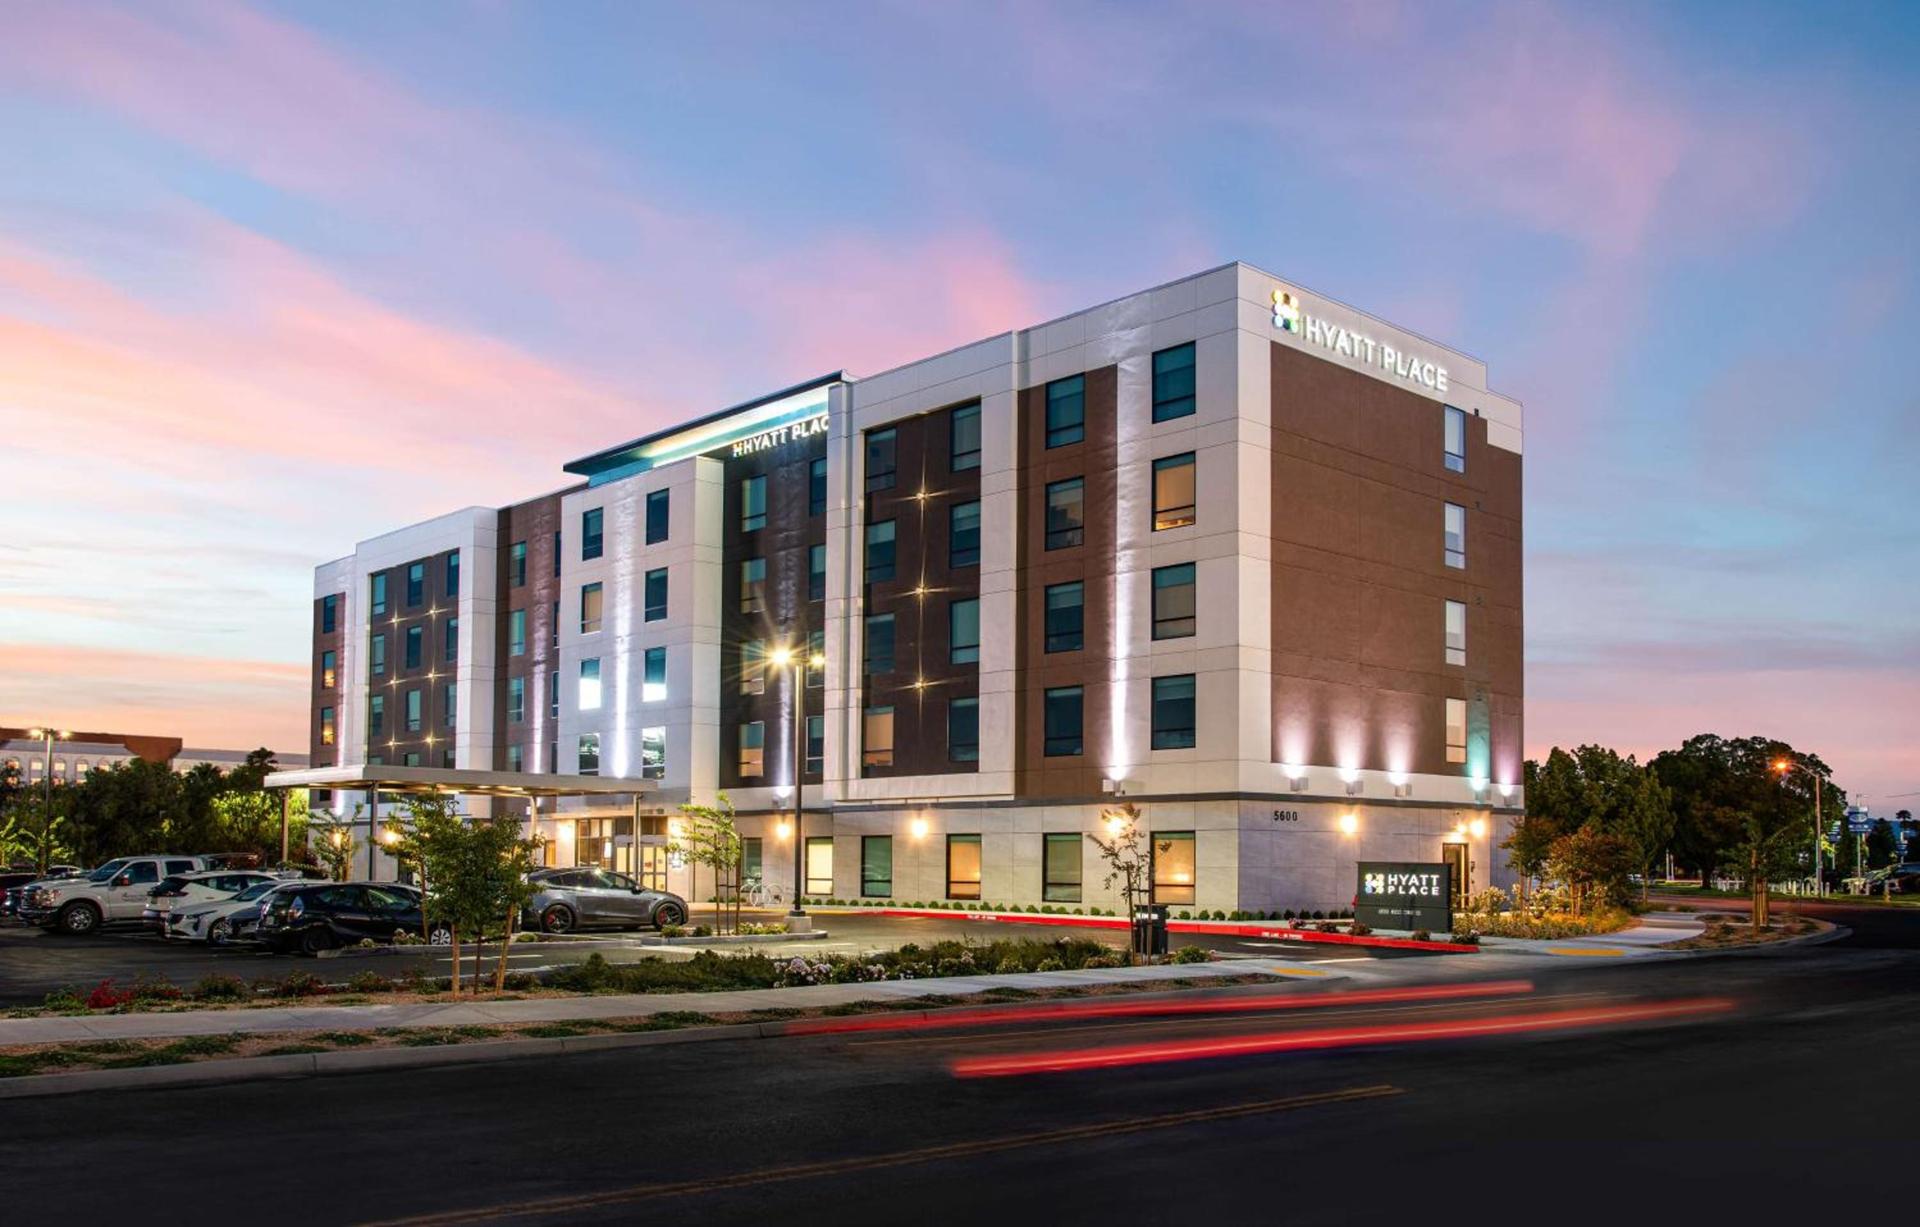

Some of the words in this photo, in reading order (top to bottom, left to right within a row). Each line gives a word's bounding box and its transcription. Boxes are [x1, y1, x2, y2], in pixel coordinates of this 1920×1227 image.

[1304, 315, 1375, 362] HYATT
[1381, 344, 1448, 391] PLACE
[744, 429, 788, 454] HYATT
[791, 416, 829, 440] PLAC
[1273, 810, 1298, 821] 5600
[1388, 874, 1440, 886] HYATT
[1387, 885, 1440, 896] PLACE
